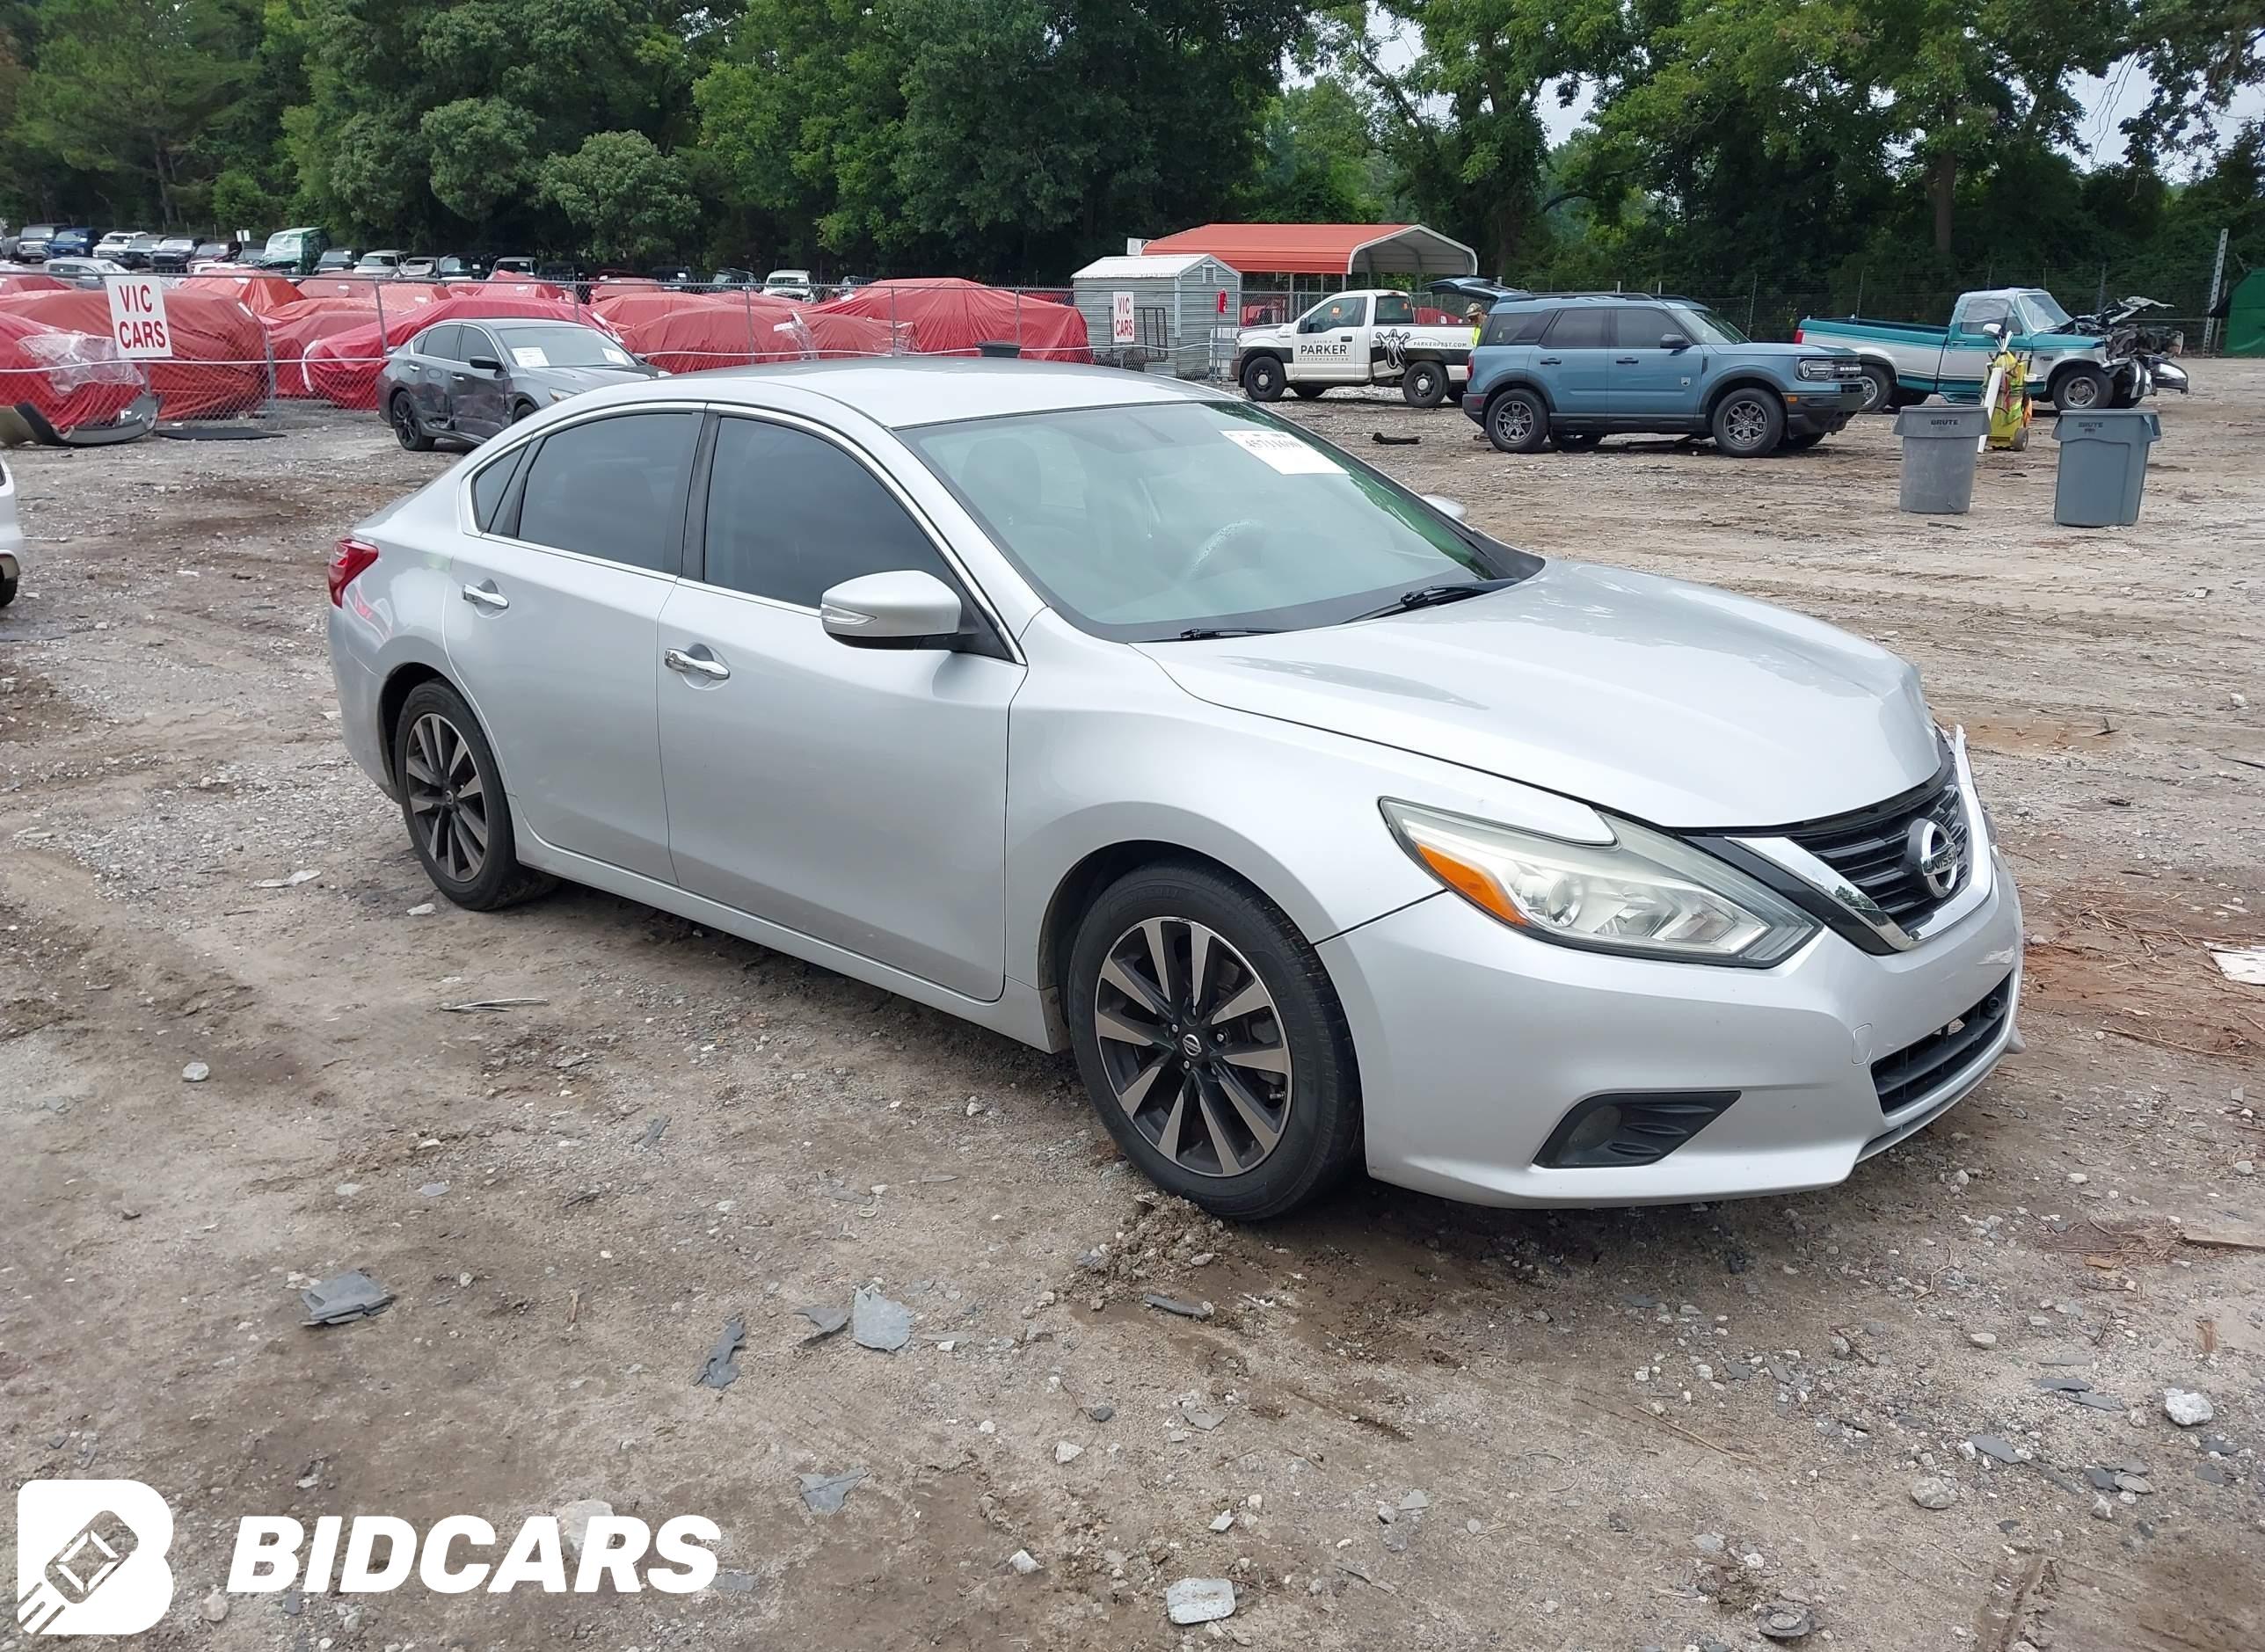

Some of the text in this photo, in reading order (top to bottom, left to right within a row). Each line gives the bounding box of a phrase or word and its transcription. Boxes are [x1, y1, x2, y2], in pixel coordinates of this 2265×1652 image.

[118, 284, 153, 313] VIC
[1118, 296, 1130, 315] VIC
[119, 320, 166, 349] CARS
[1115, 319, 1133, 337] CARS
[1300, 344, 1347, 355] PARKER
